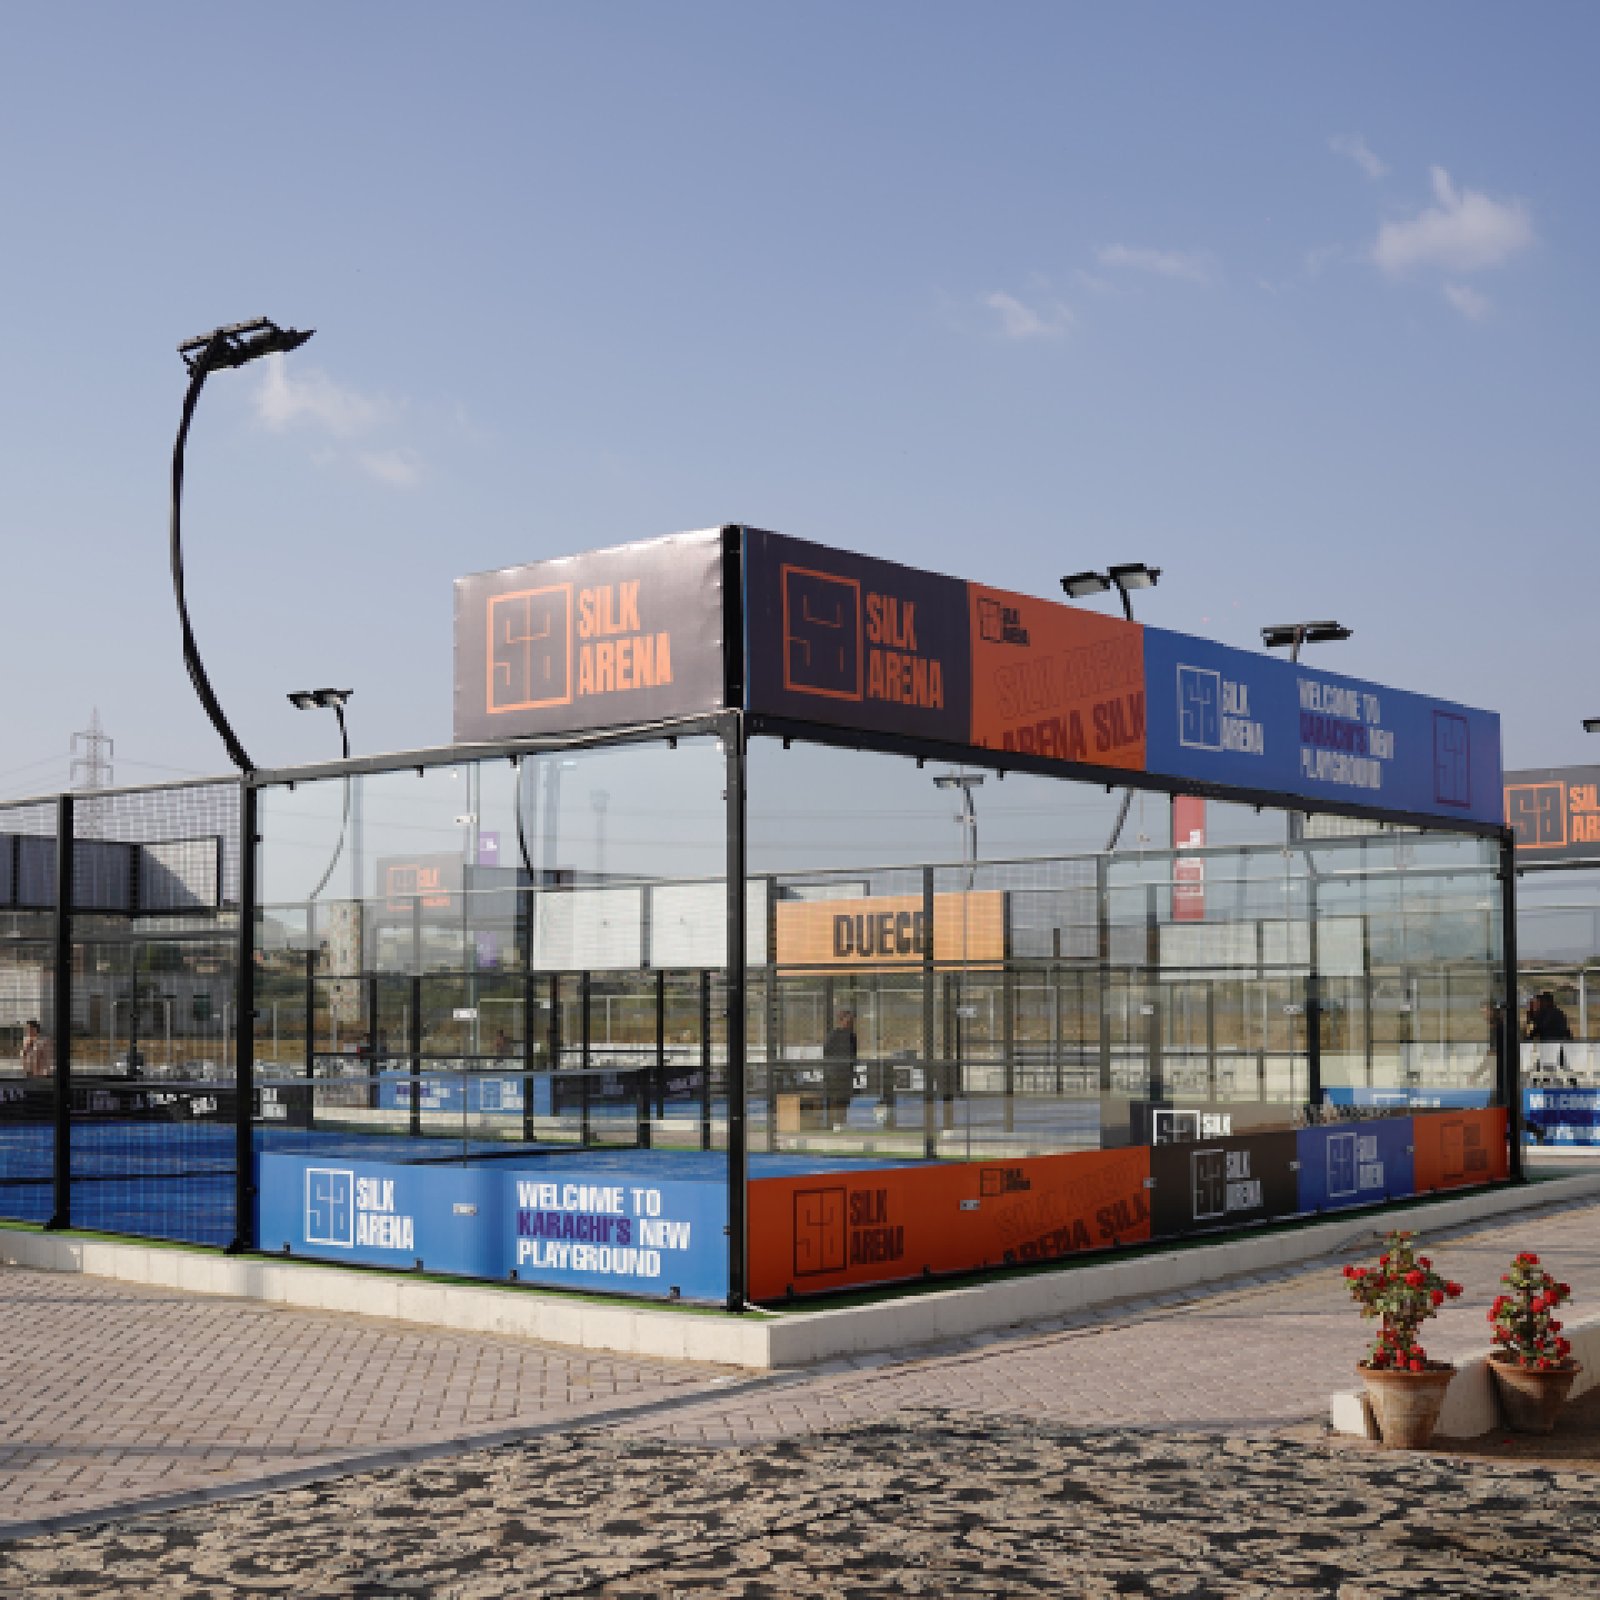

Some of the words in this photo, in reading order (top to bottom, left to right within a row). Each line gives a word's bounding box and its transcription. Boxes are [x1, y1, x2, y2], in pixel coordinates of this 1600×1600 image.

[577, 579, 641, 639] SILK
[866, 592, 917, 651] SILK
[577, 631, 674, 697] ARENA
[866, 649, 944, 710] ARENA
[1570, 815, 1600, 843] AR
[356, 1177, 396, 1213] SILK
[516, 1181, 624, 1216] WELCOME
[630, 1187, 662, 1217] TO
[849, 1188, 888, 1226] SILK
[356, 1212, 415, 1251] ARENA
[516, 1209, 632, 1246] KARACHI'S
[638, 1218, 692, 1250] NEW
[516, 1237, 662, 1278] PLAYGROUND
